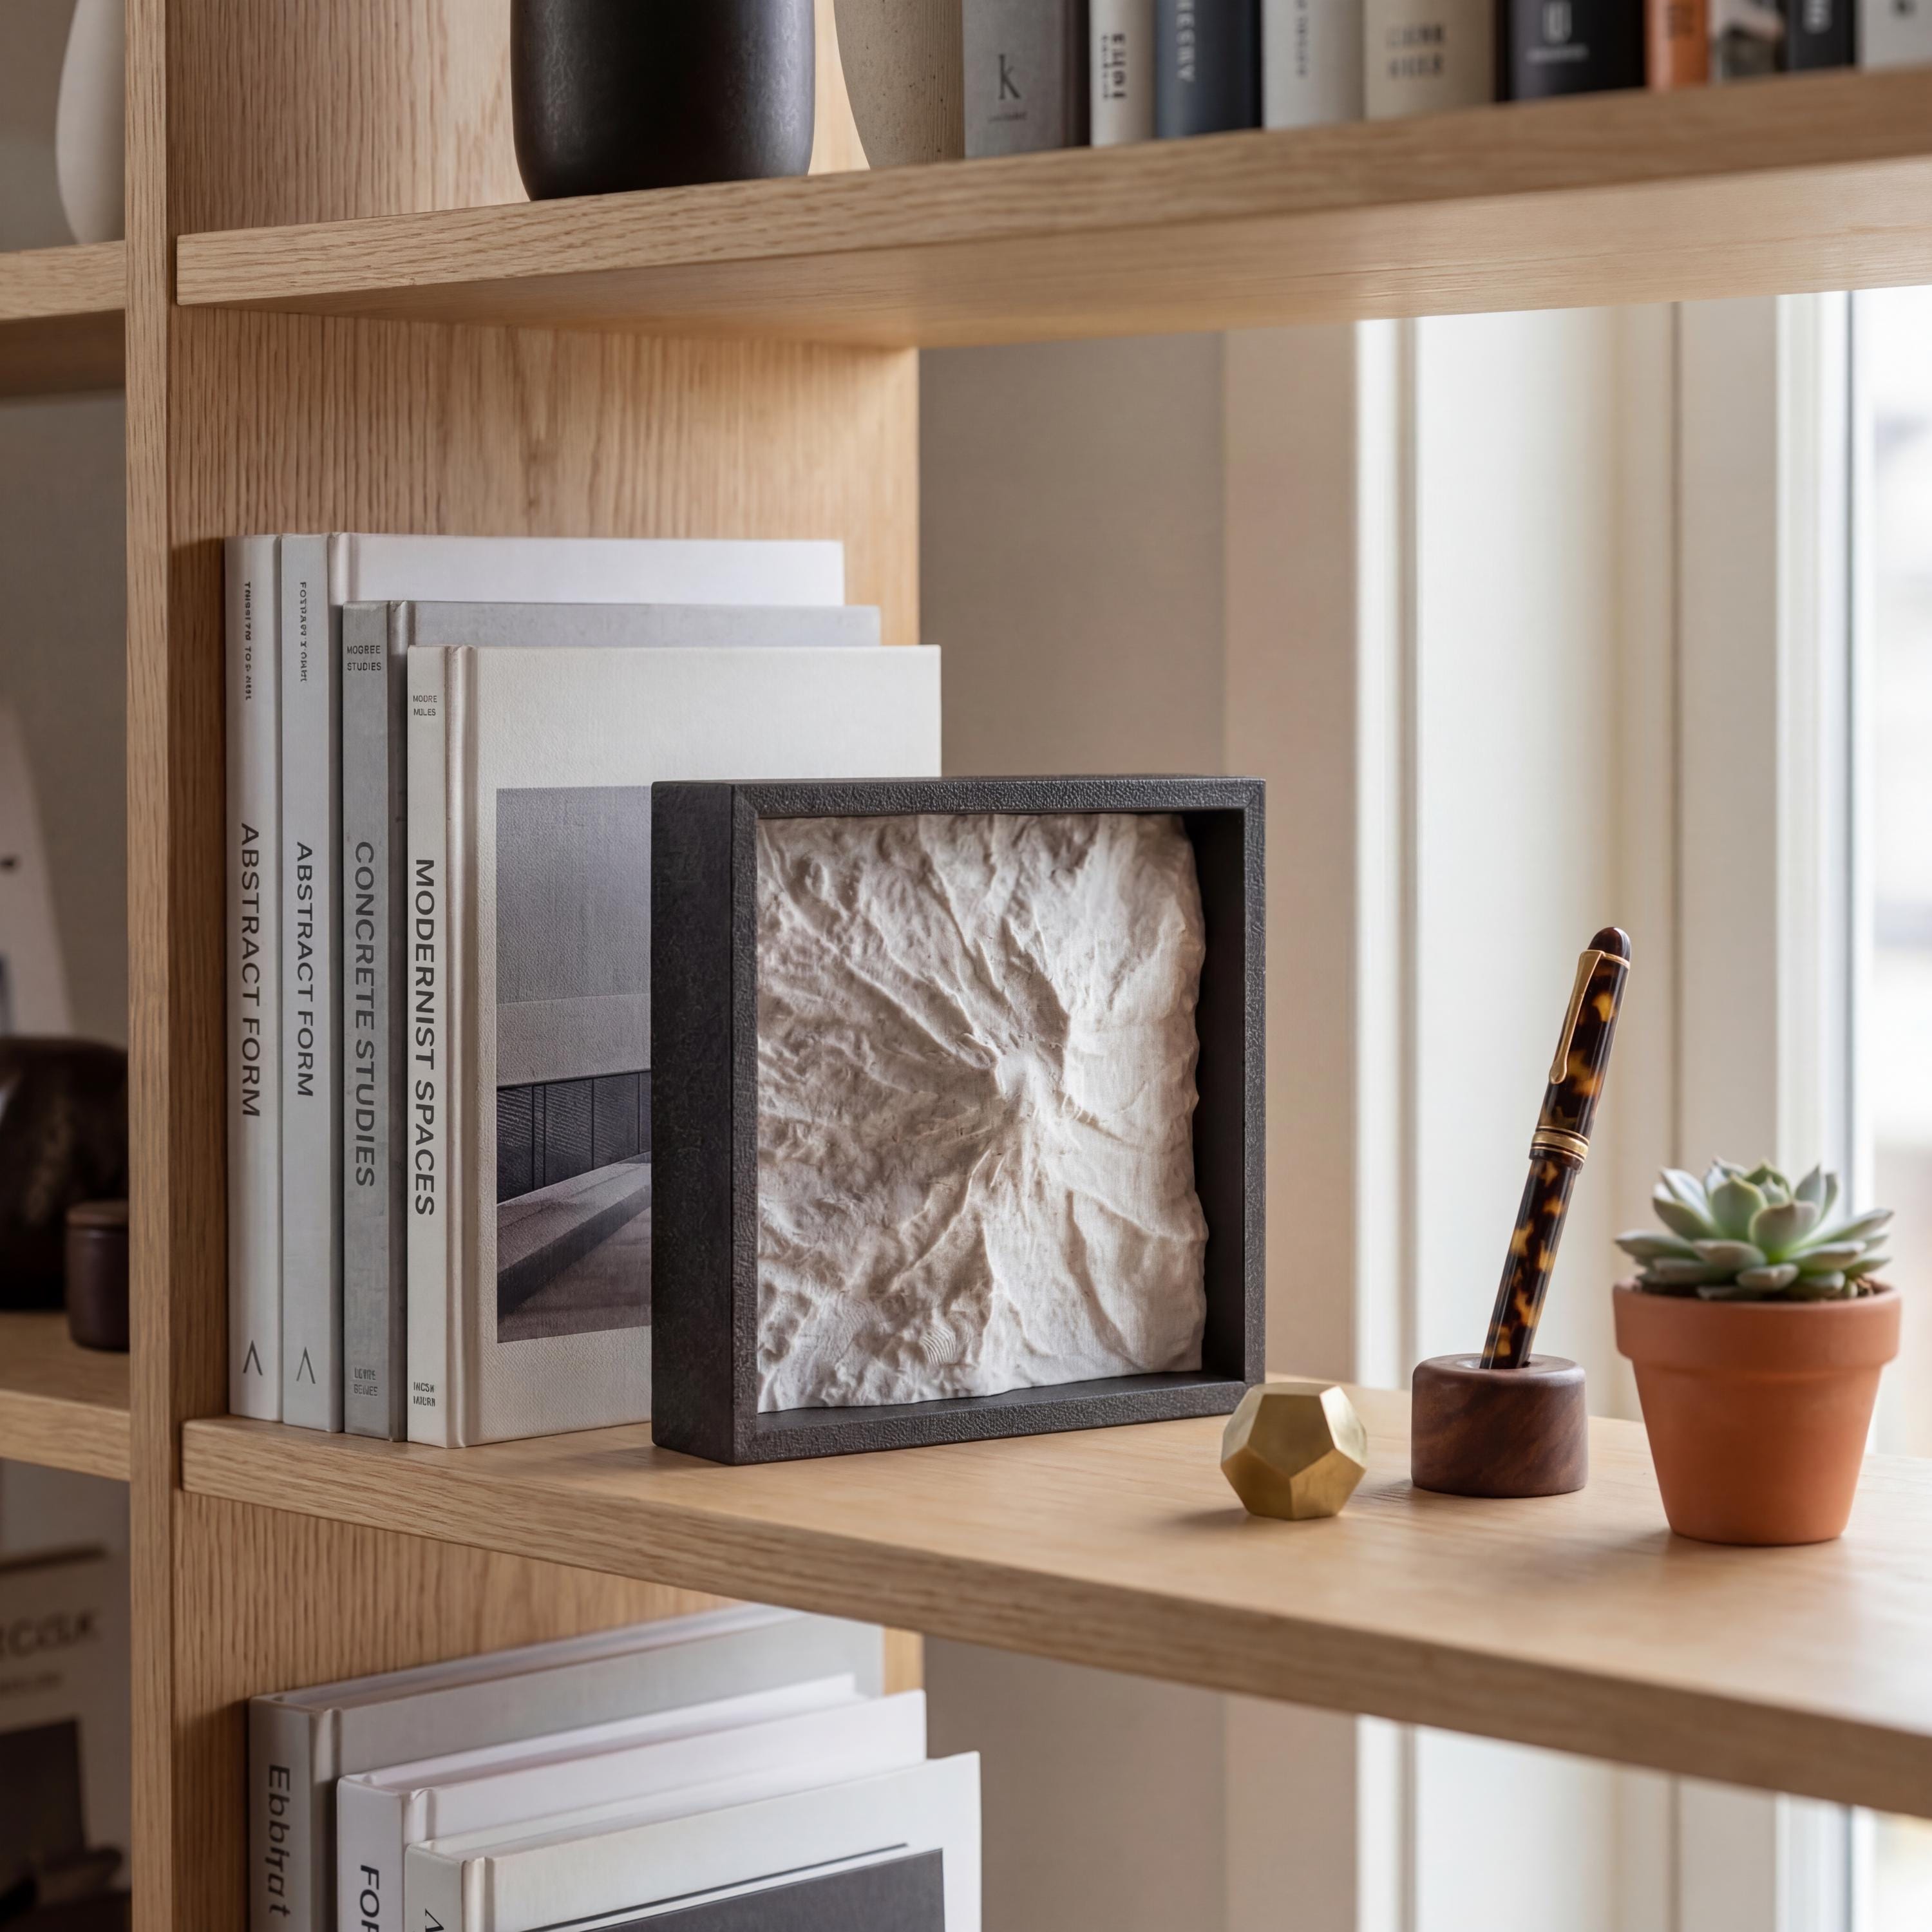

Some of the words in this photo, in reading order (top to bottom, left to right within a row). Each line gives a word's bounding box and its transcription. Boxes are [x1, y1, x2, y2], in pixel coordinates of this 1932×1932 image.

[346, 661, 382, 671] STUDIES
[412, 695, 438, 703] MOORE
[241, 823, 261, 1007] ABSTRACT
[297, 841, 314, 1003] ABSTRACT
[355, 841, 375, 1030] CONCRETE
[415, 859, 435, 1070] MODERNIST
[241, 1017, 261, 1117] FORM
[297, 1010, 314, 1097] FORM
[355, 1039, 375, 1187] STUDIES
[415, 1079, 435, 1216] SPACES
